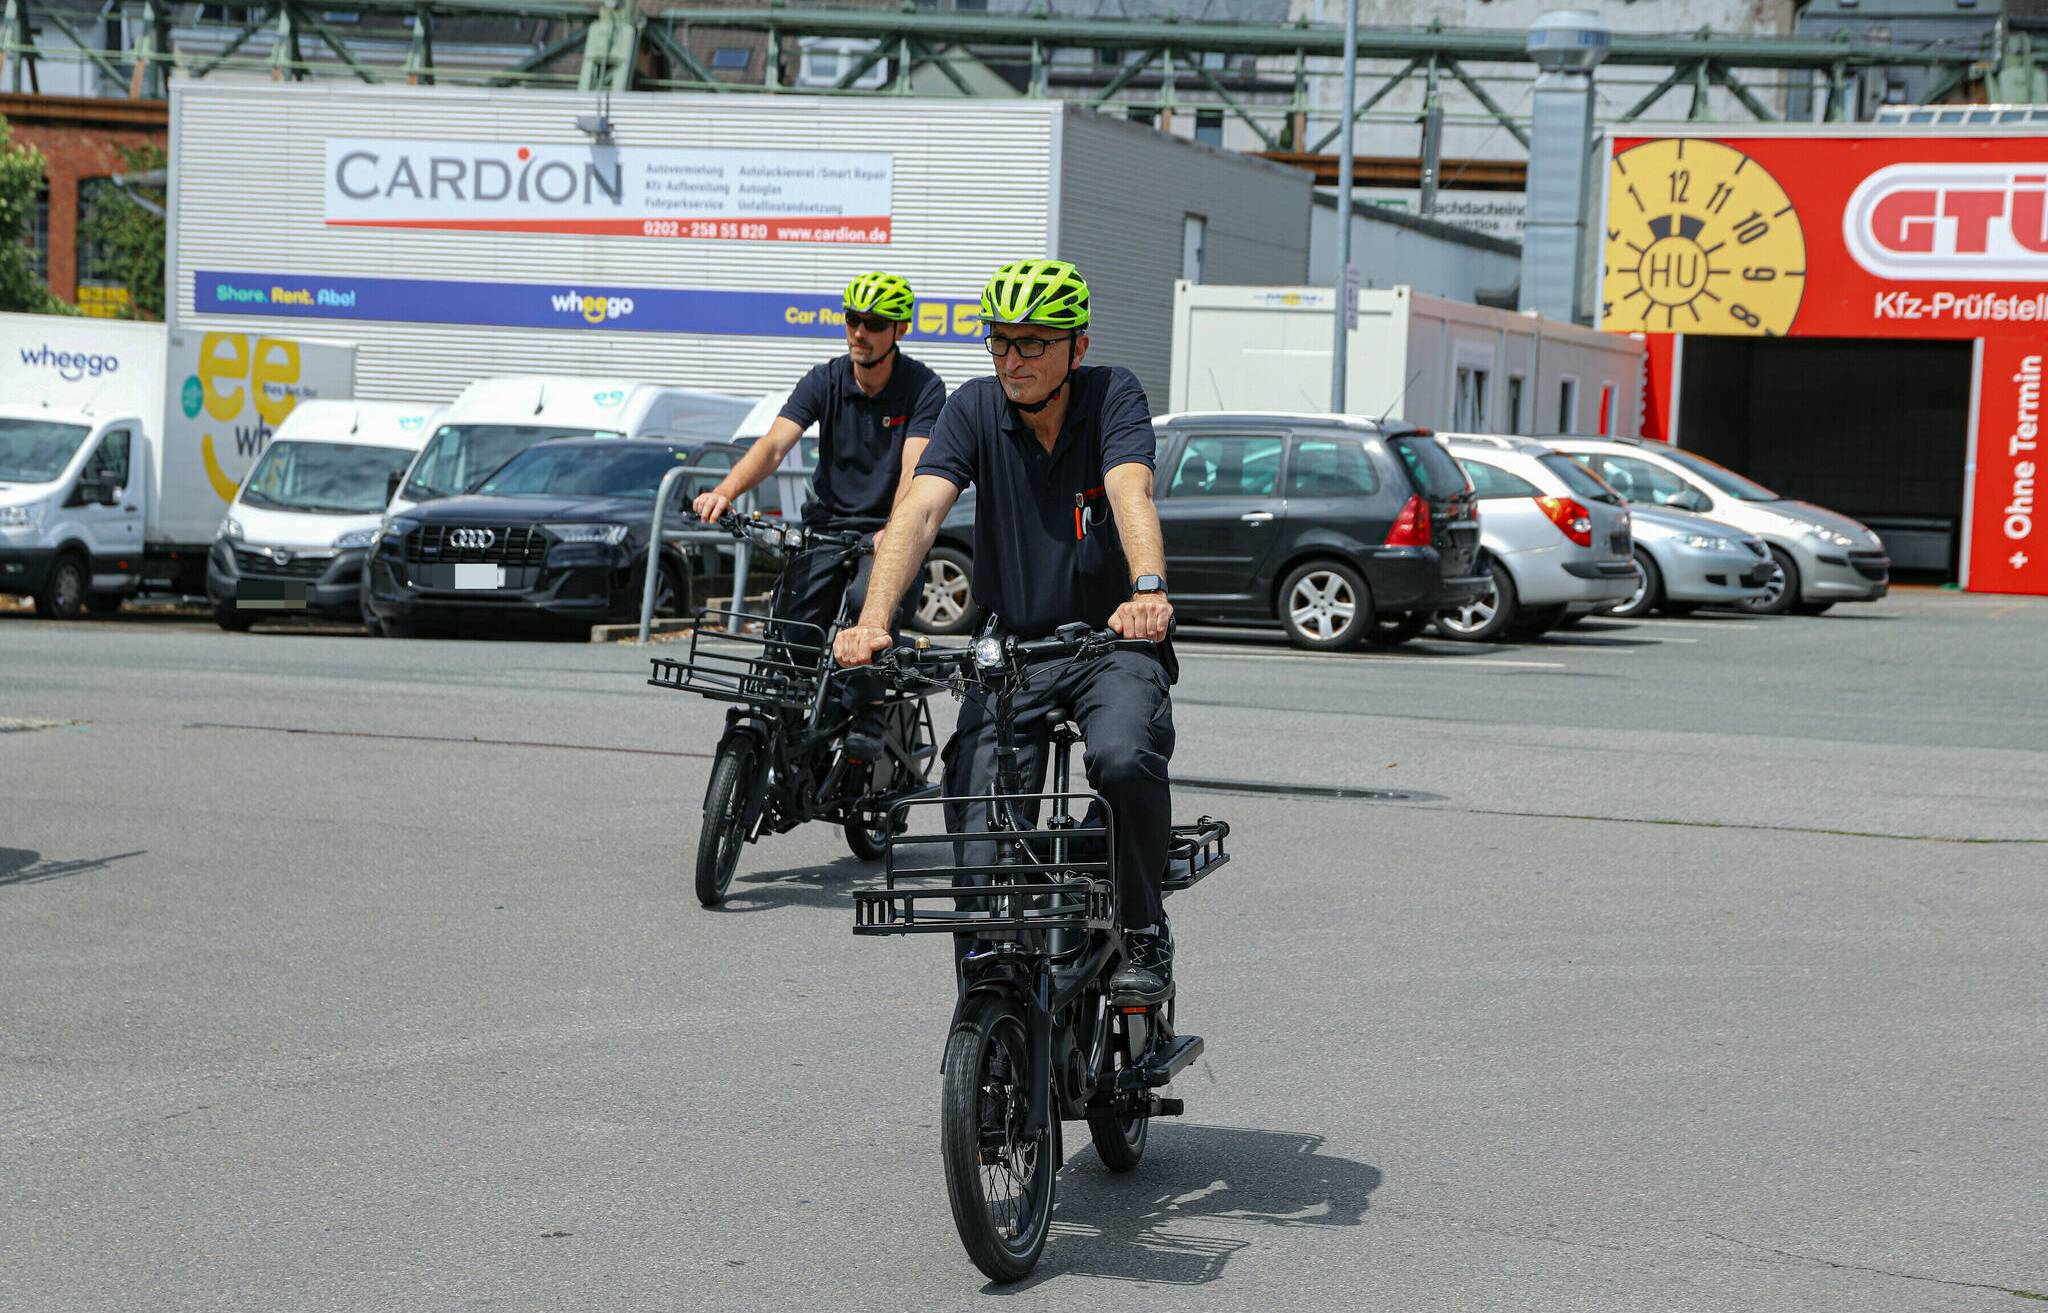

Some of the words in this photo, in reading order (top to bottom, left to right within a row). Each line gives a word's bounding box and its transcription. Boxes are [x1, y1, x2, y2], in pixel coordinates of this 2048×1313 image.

[646, 163, 724, 178] Autovermietung
[854, 168, 887, 181] Repair
[738, 184, 782, 197] Autoglas
[1669, 169, 1693, 203] 12
[1705, 181, 1736, 215] 11
[645, 197, 723, 211] Fuhrparkservice
[643, 221, 679, 237] 0202
[777, 225, 888, 243] www.cardion.de
[1732, 210, 1770, 245] 10
[1650, 253, 1699, 289] HU
[216, 284, 269, 303] Share.
[271, 286, 315, 305] Rent.
[317, 288, 356, 307] Abo!
[551, 290, 634, 324] wheego
[785, 306, 817, 325] Car
[1729, 303, 1761, 329] 8
[20, 344, 119, 381] wheego
[2008, 354, 2043, 457] Termin
[2003, 460, 2036, 540] Ohne
